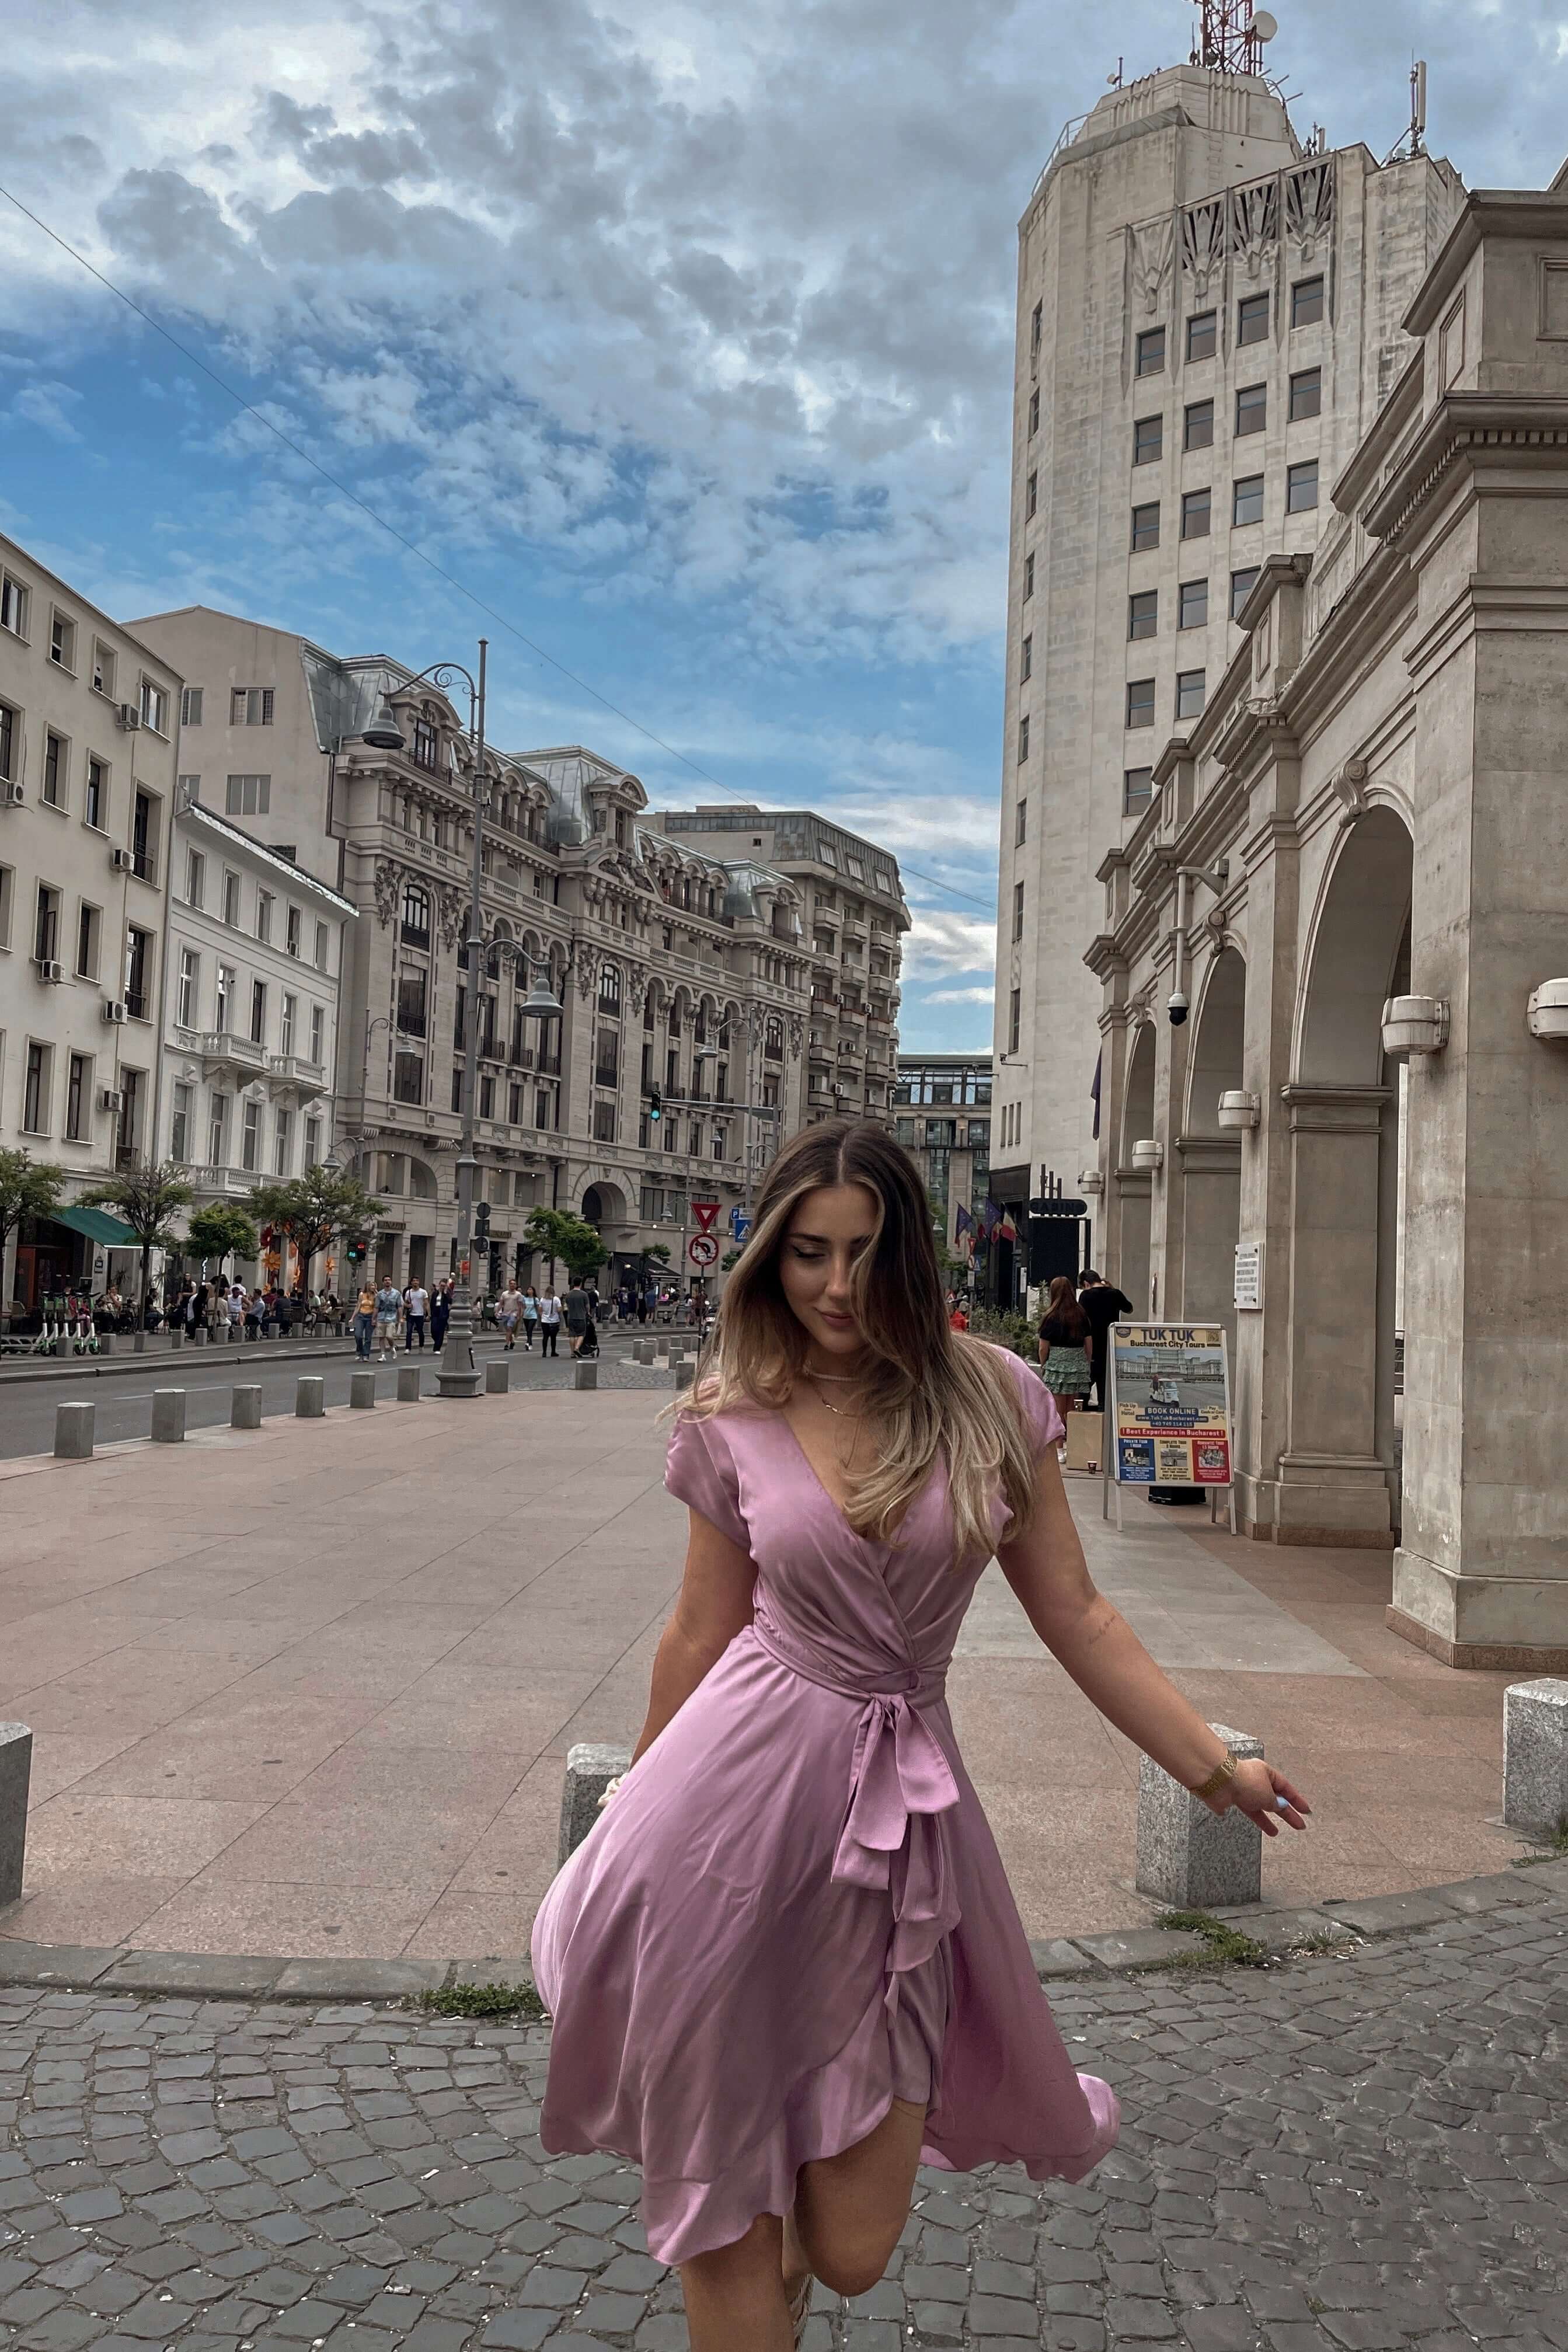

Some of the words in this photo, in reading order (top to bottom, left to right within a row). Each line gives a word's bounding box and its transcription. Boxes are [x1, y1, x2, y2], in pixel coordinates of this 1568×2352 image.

[1141, 1329, 1167, 1341] TUK
[1169, 1329, 1195, 1341] TUK
[1168, 1341, 1183, 1349] City
